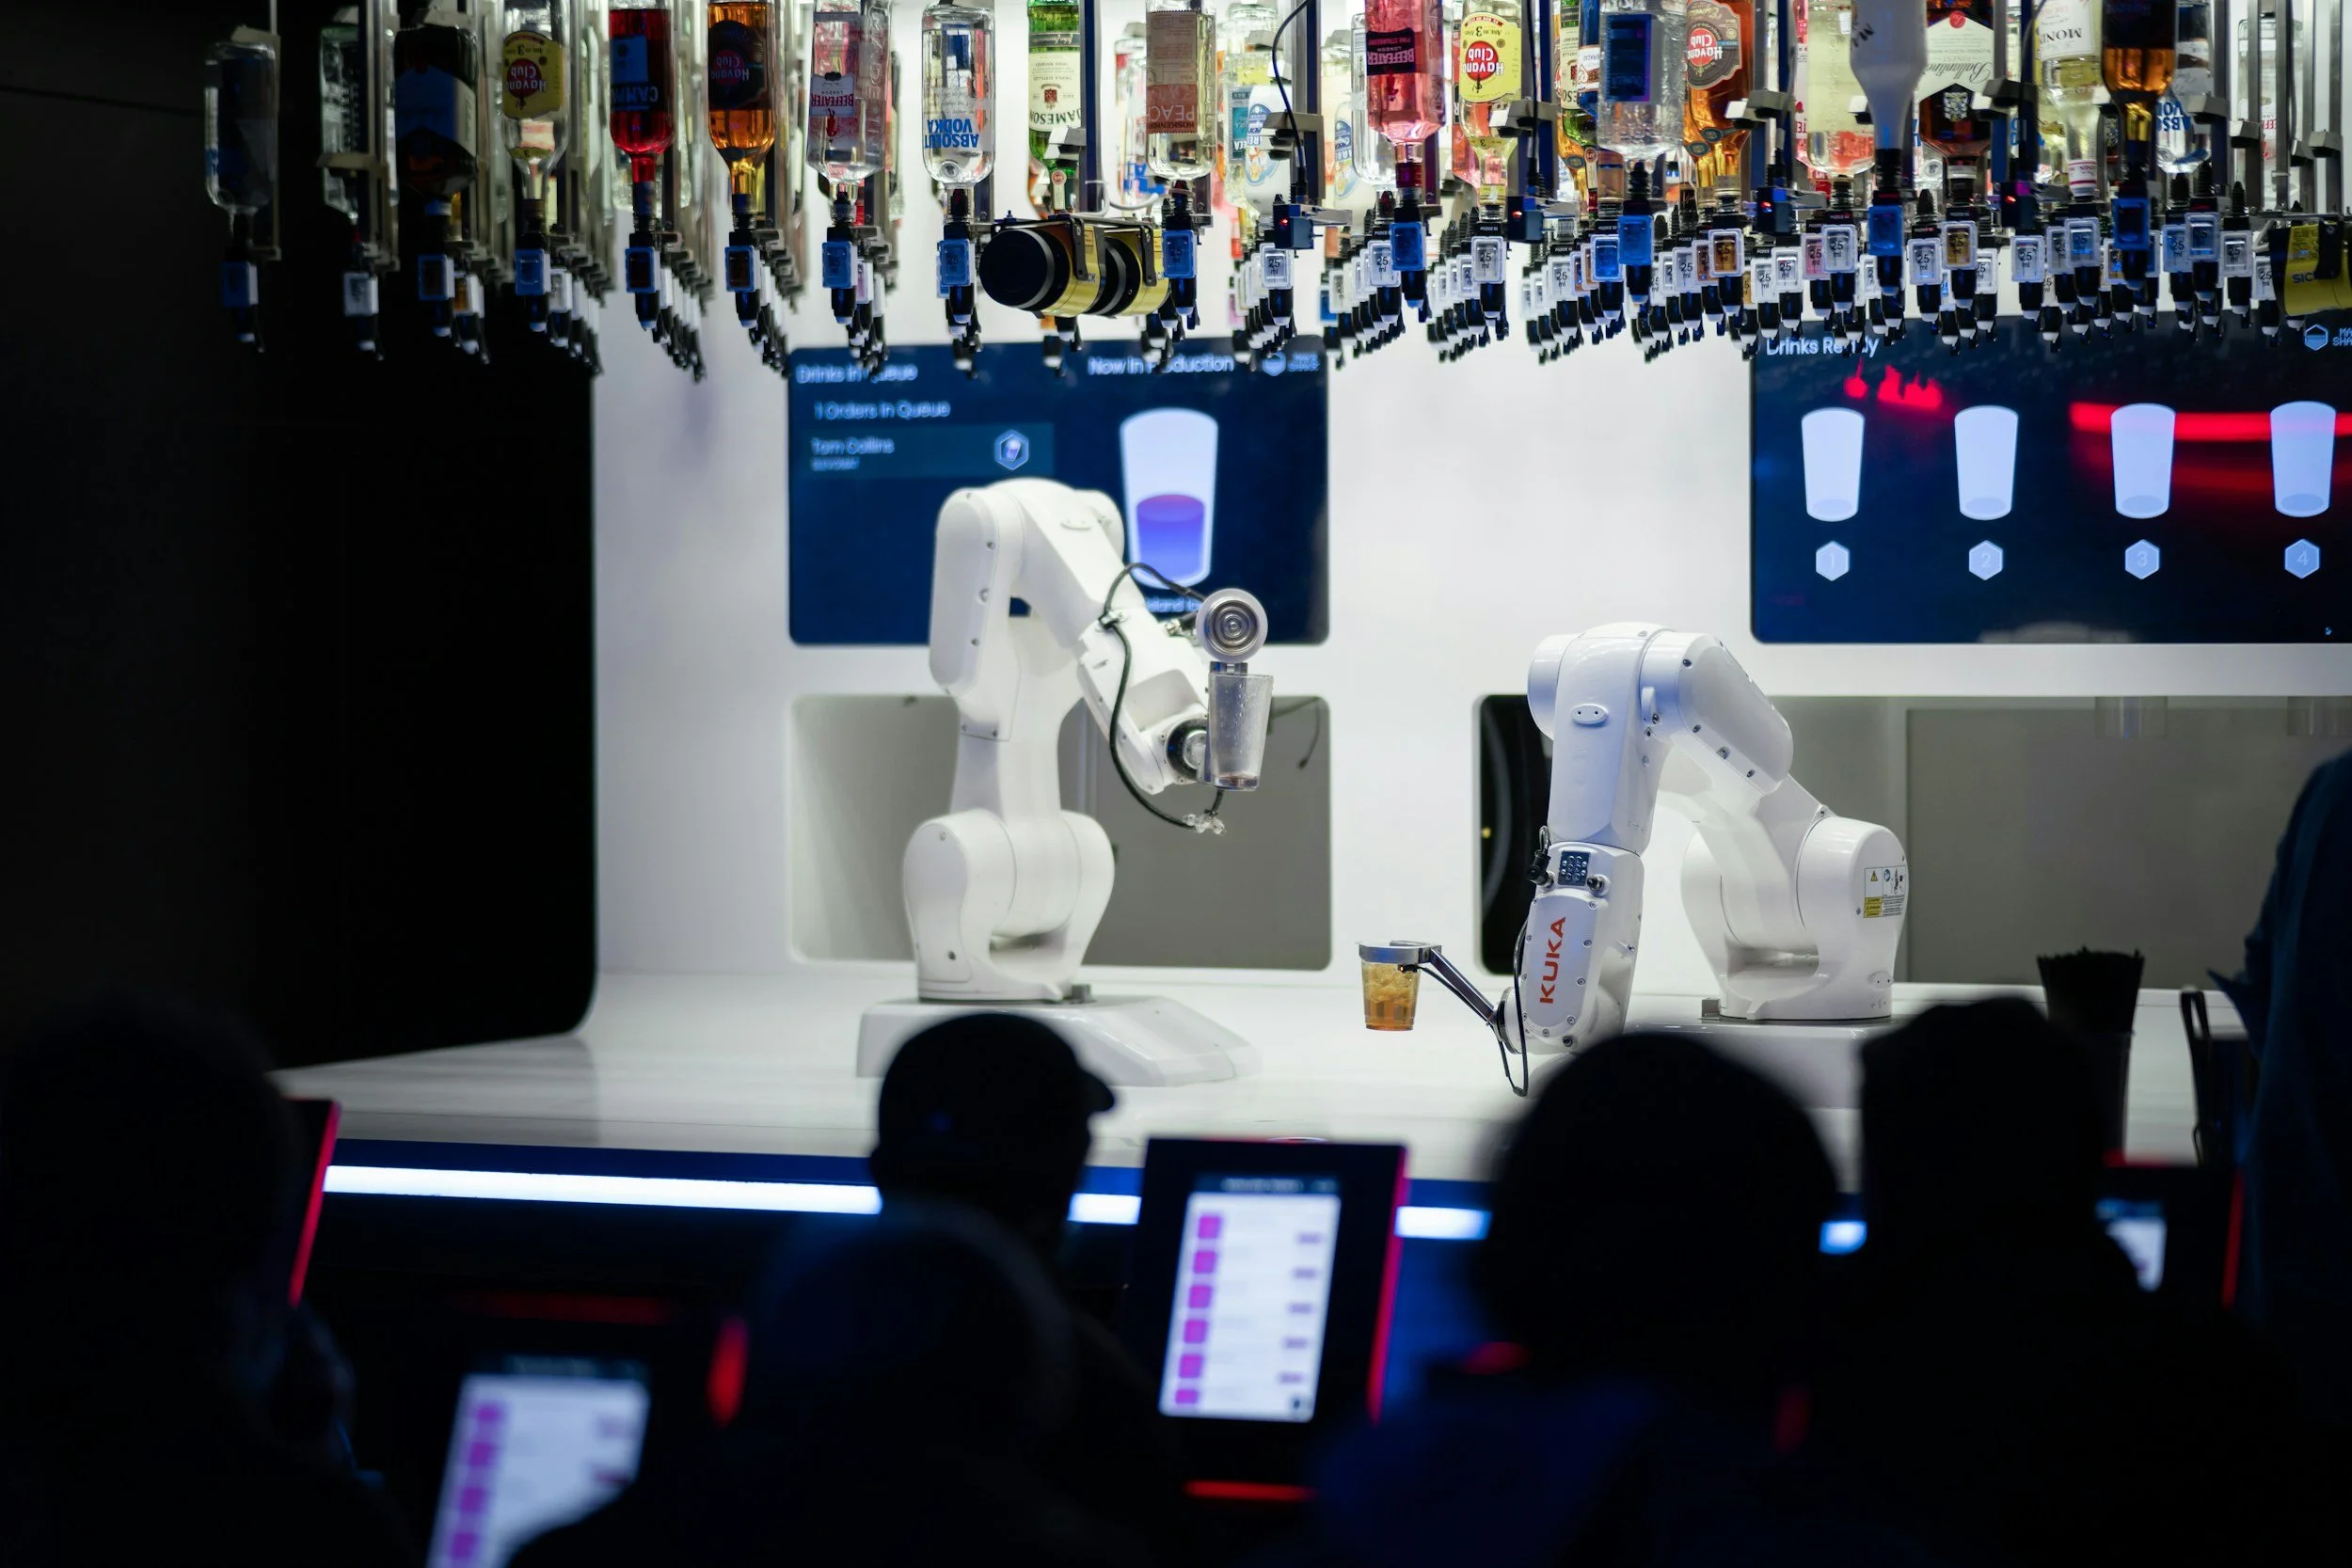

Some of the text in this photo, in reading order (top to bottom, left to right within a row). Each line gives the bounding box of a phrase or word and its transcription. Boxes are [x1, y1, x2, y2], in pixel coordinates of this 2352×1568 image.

[1475, 26, 1483, 37] 3
[1691, 34, 1713, 48] Club
[1367, 48, 1415, 65] BEEFEATER
[1468, 48, 1494, 60] Club
[716, 56, 740, 68] Club
[510, 66, 537, 79] Club
[710, 69, 750, 81] Havana
[811, 94, 854, 107] BEEFEATER
[1029, 108, 1081, 125] JAMESON
[1146, 104, 1195, 122] PEACH
[927, 119, 973, 133] VODKA
[924, 134, 979, 149] ABSOLUT
[1831, 241, 1844, 250] 25
[2173, 241, 2185, 250] 25
[2228, 245, 2240, 256] 25
[1480, 253, 1492, 262] 25
[1809, 249, 1822, 259] 25
[1917, 254, 1930, 263] 25
[2019, 251, 2031, 261] 25
[1268, 259, 1280, 268] 25
[1376, 256, 1389, 265] 25
[1680, 263, 1693, 272] 25
[1780, 263, 1791, 272] 25
[1556, 272, 1567, 281] 25
[1759, 274, 1772, 282] 25
[2260, 271, 2272, 280] 25
[2292, 272, 2313, 283] SIC
[1766, 336, 1819, 356] Drinks
[1089, 356, 1125, 374] Now
[823, 402, 878, 420] Orders
[896, 400, 951, 420] Queue
[1829, 553, 1835, 568] 1
[1980, 552, 1991, 568] 2
[2137, 551, 2148, 566] 3
[2296, 551, 2309, 566] 4
[1539, 916, 1566, 1005] KUKA
